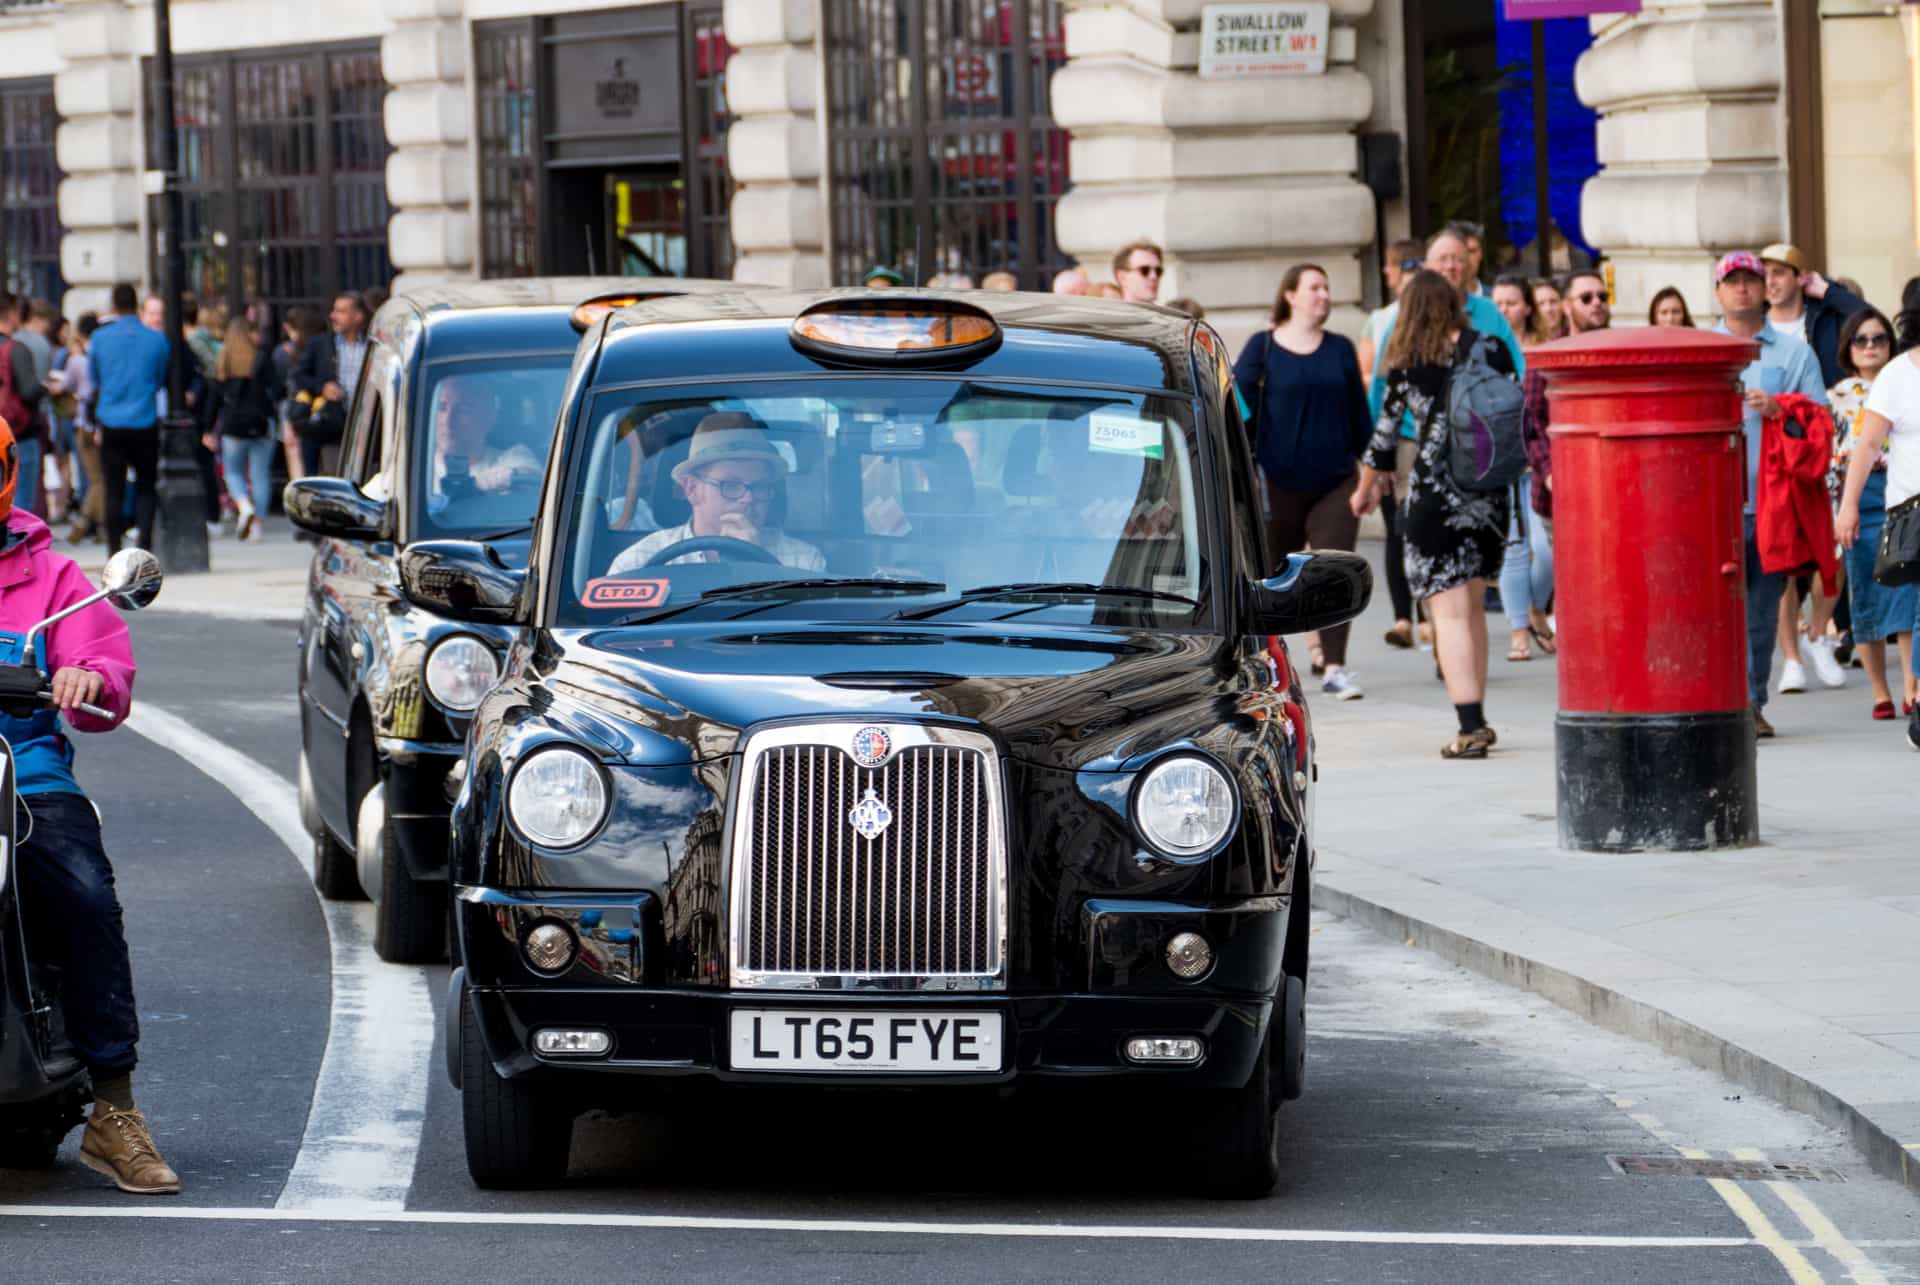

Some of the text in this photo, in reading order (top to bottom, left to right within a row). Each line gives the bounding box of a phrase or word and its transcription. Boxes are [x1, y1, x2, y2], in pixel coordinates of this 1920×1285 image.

[1216, 12, 1308, 31] SWALLOW
[1290, 33, 1317, 51] W1
[600, 588, 647, 598] LTDA
[753, 1017, 980, 1061] LT65 FYE
